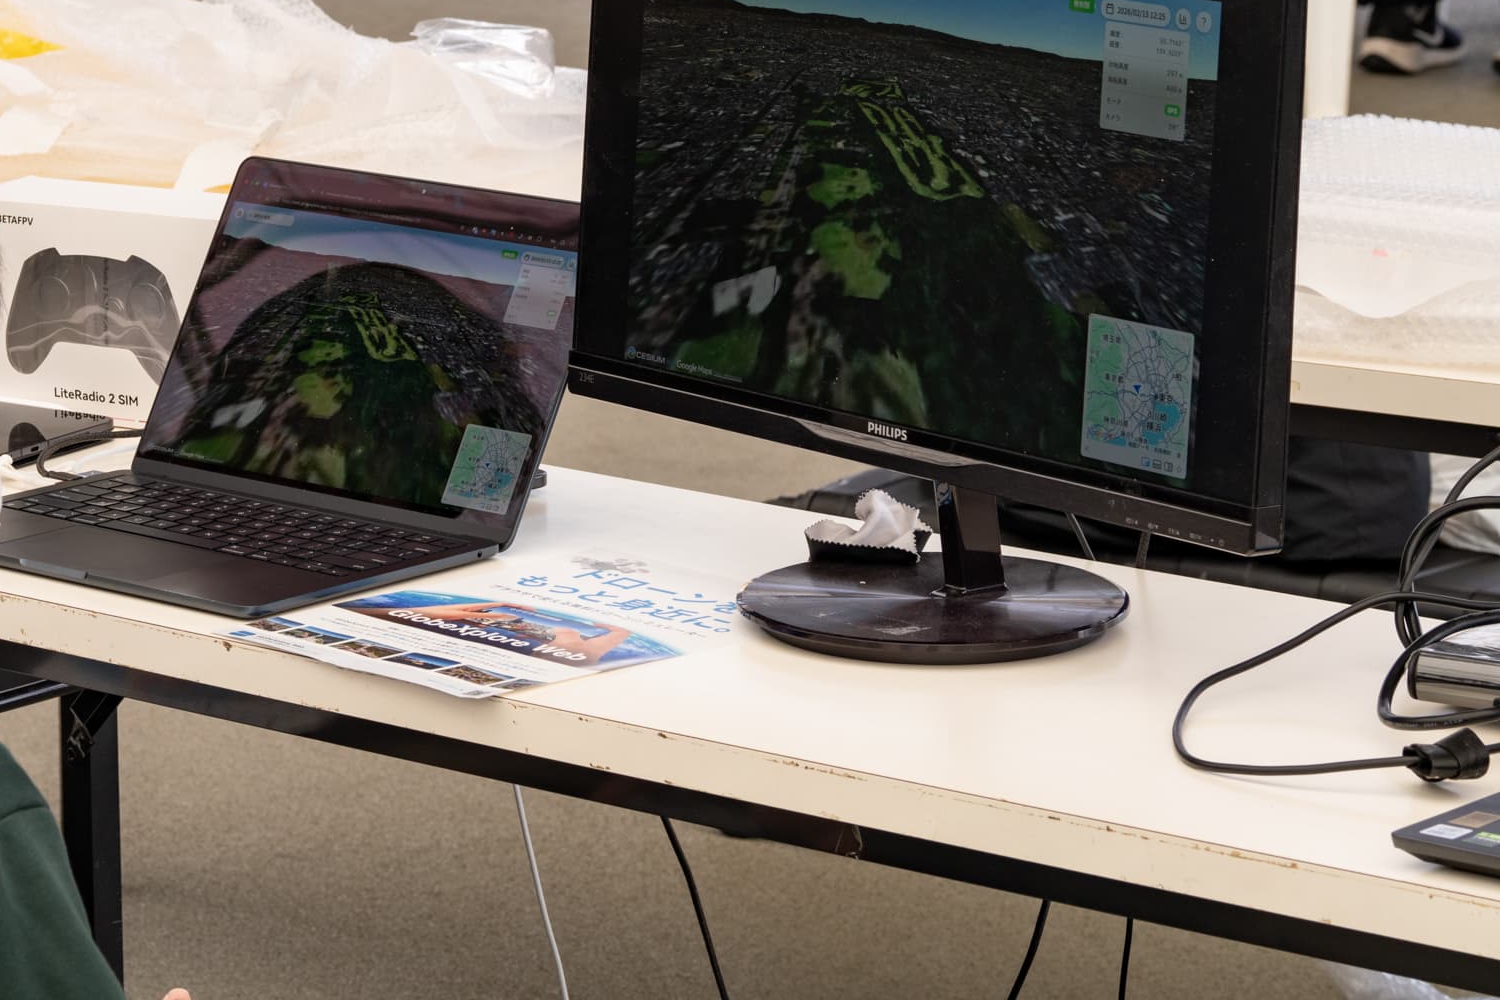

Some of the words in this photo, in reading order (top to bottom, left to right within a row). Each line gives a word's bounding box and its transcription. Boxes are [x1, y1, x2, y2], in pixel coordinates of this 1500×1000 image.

[635, 351, 667, 364] CESIUM
[53, 386, 106, 403] LiteRadio
[108, 393, 116, 404] 2
[118, 394, 139, 407] SIM
[866, 421, 909, 441] PHILIPS
[516, 574, 732, 633] もっと身近に。
[387, 608, 532, 649] GlobeXplore
[531, 643, 588, 662] Web
